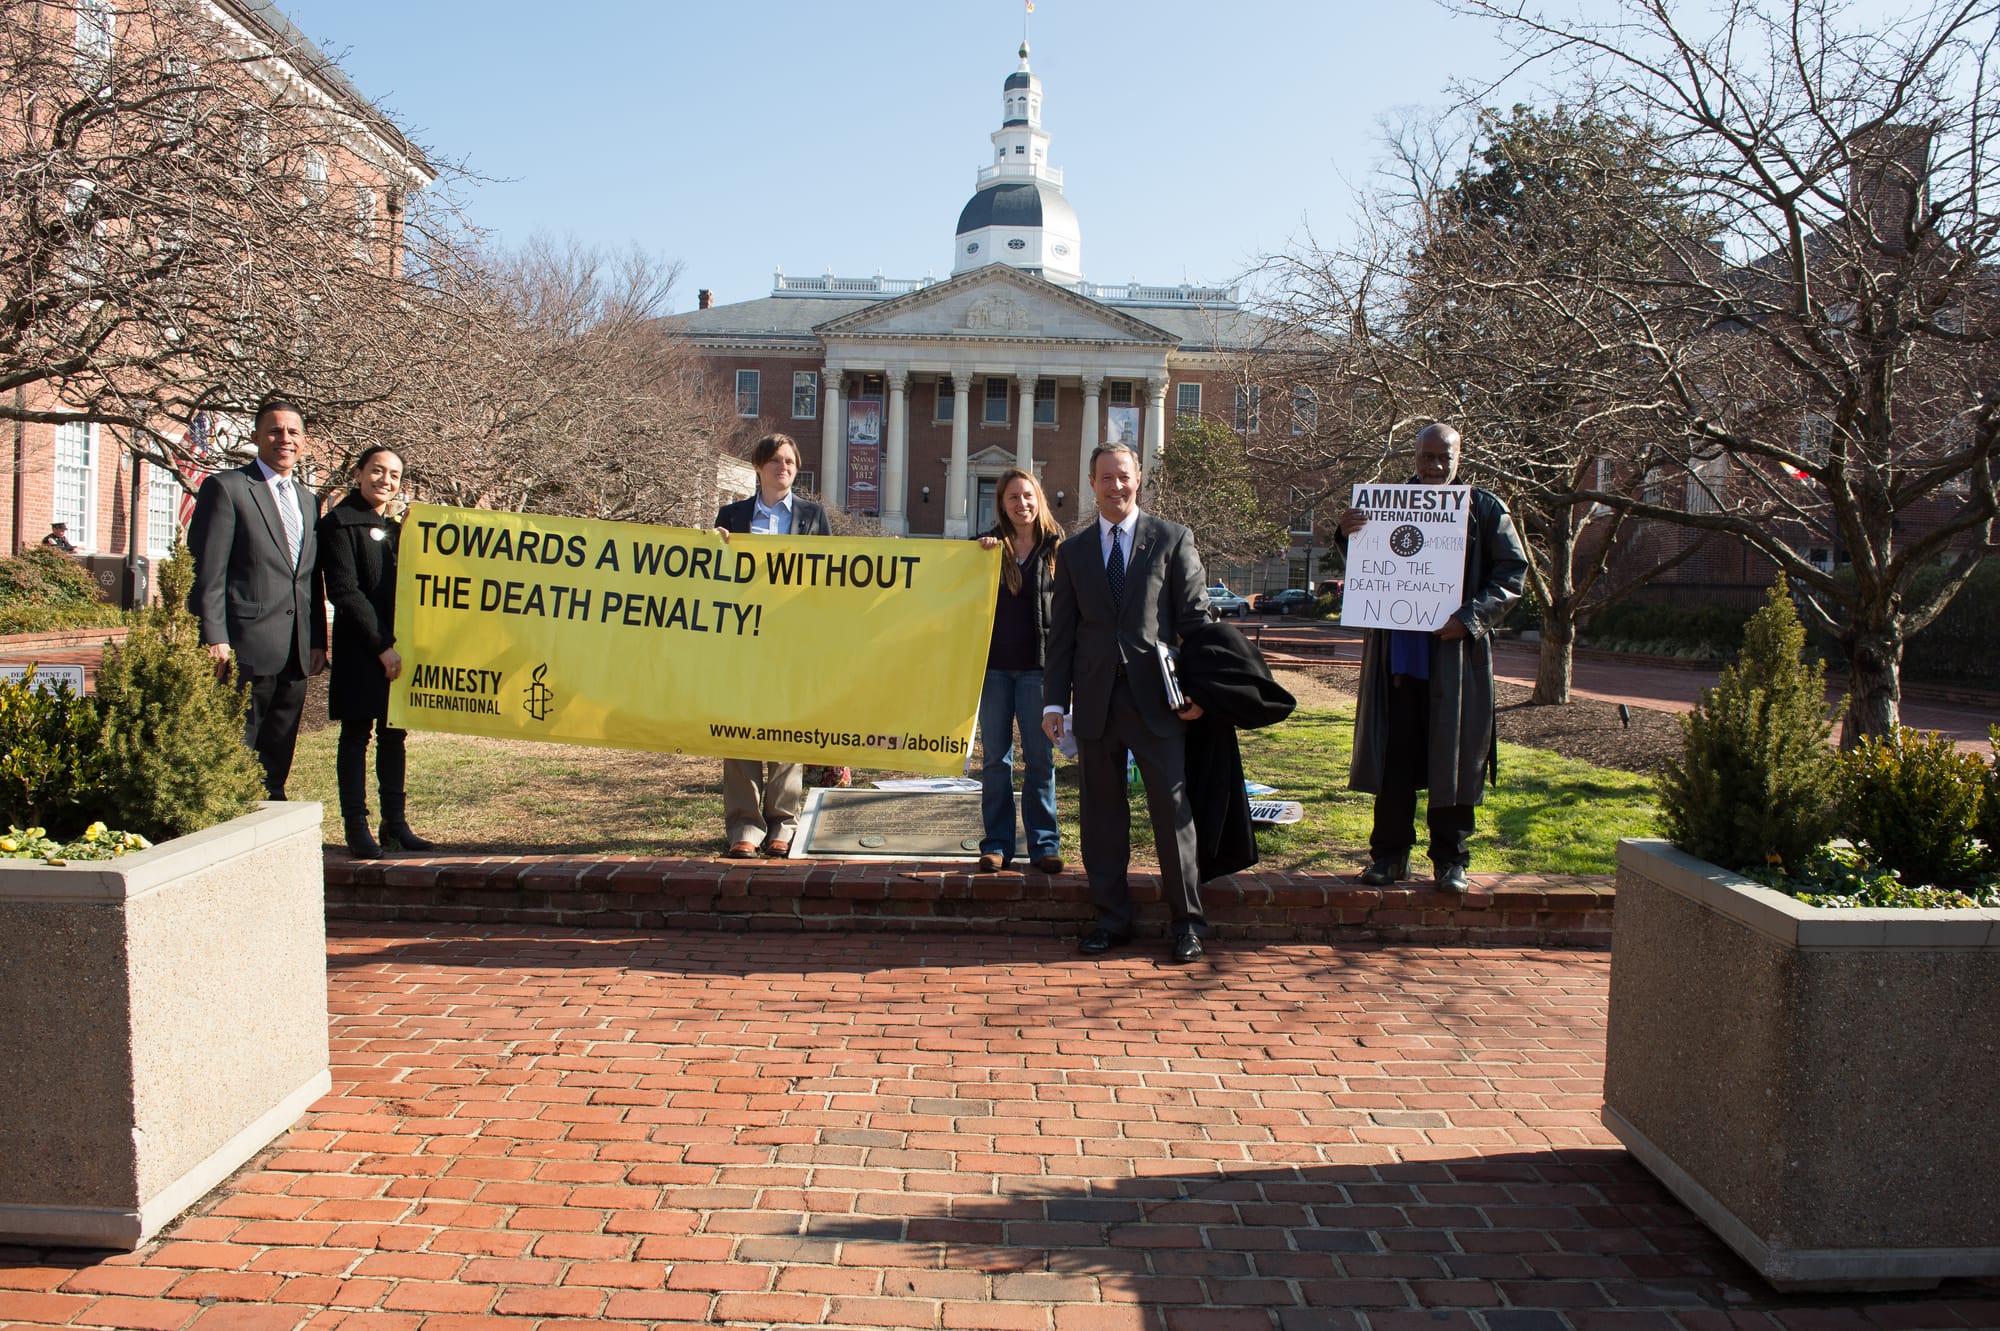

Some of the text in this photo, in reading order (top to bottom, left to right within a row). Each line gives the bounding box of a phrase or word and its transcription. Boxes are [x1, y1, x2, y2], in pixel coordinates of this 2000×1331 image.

[855, 471, 873, 479] 1812
[1355, 489, 1466, 510] AMNESTY
[418, 521, 921, 589] TOWARDS A WORLD WITHOUT
[1362, 560, 1435, 576] END THE
[1349, 578, 1455, 595] DEATH PENALTY
[415, 573, 762, 637] THE DEATH PENALTY!
[1363, 599, 1440, 626] NOW
[411, 664, 503, 695] AMNESTY
[409, 692, 501, 715] INTERNATIONAL
